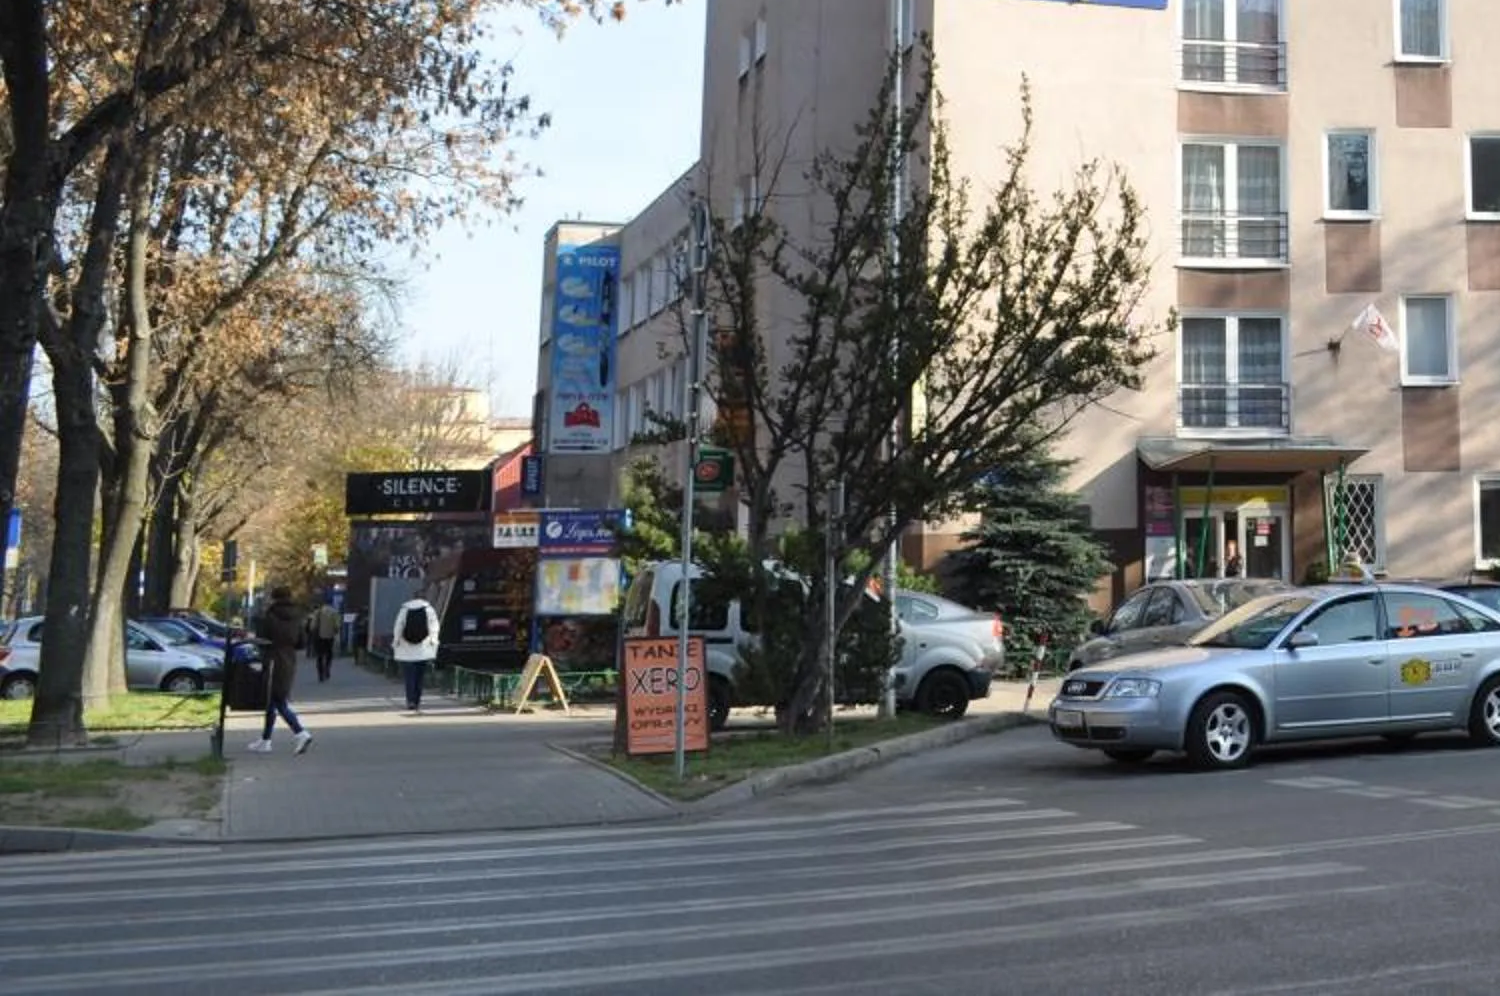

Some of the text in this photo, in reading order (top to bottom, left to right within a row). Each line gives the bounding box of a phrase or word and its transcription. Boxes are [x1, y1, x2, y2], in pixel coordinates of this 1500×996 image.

[383, 477, 457, 495] SILENCE
[631, 666, 701, 694] XERO
[634, 703, 698, 717] WYDRKI
